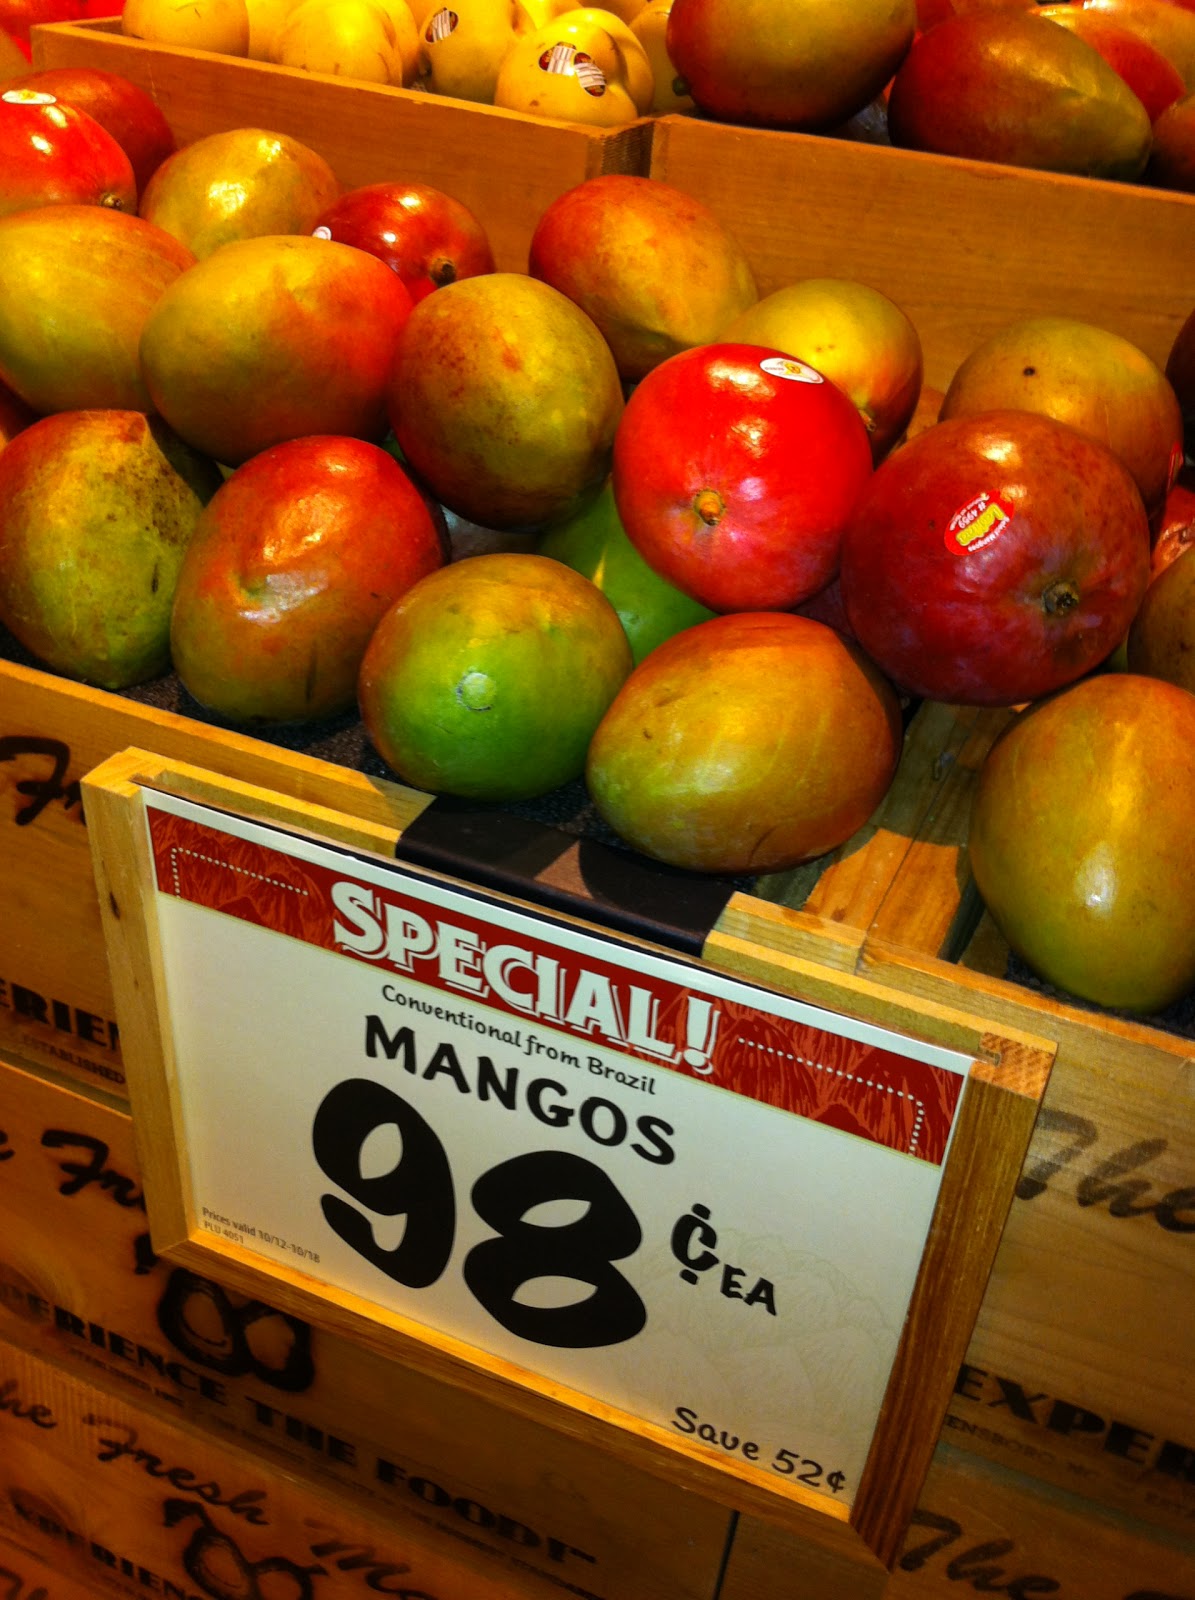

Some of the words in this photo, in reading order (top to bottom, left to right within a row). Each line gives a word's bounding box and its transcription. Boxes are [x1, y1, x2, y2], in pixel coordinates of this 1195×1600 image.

[958, 509, 978, 529] 4959
[331, 880, 721, 1075] SPECIAL!
[365, 1014, 676, 1165] MANGOS
[382, 984, 522, 1047] Conventional
[521, 1035, 581, 1068] from
[586, 1056, 656, 1096] Brazil
[202, 1206, 232, 1229] Prices
[231, 1216, 257, 1238] valid
[258, 1230, 321, 1264] 10/12-10/18
[204, 1220, 223, 1237] PLU
[223, 1227, 245, 1245] 4051
[82, 1412, 271, 1527] Fresh
[671, 1406, 760, 1462] Save
[771, 1447, 847, 1494] 52¢
